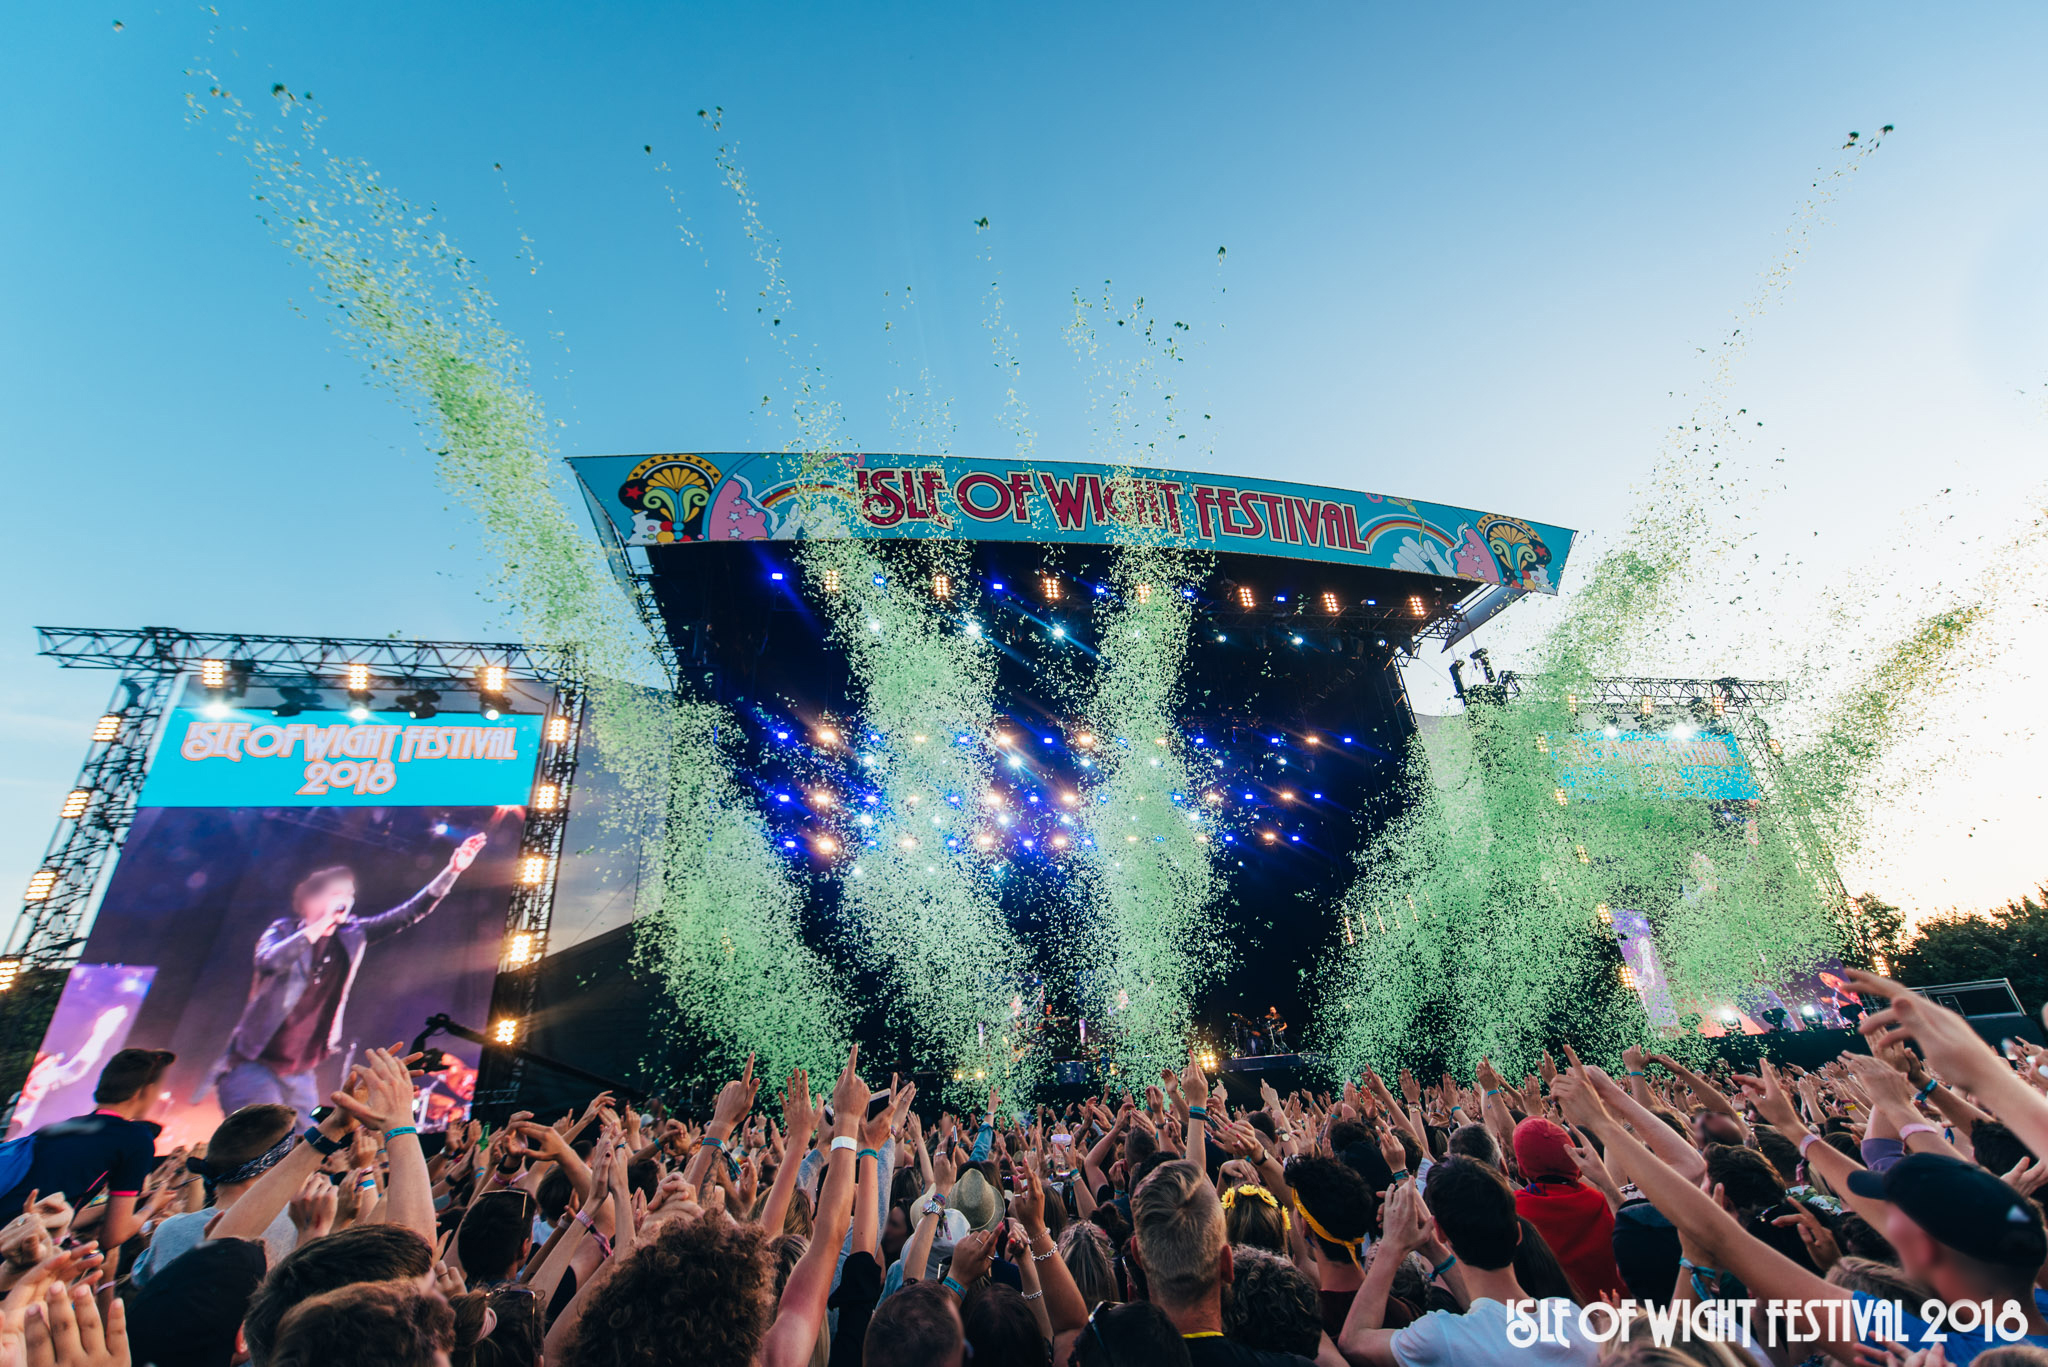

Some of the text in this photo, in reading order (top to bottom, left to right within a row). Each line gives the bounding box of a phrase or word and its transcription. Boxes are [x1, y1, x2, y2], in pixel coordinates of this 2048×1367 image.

[853, 467, 1372, 555] ISLE OF WIGHT FESTIVAL
[180, 721, 518, 762] ISLE OF WIGHT FESTIVAL
[294, 760, 397, 795] 2018
